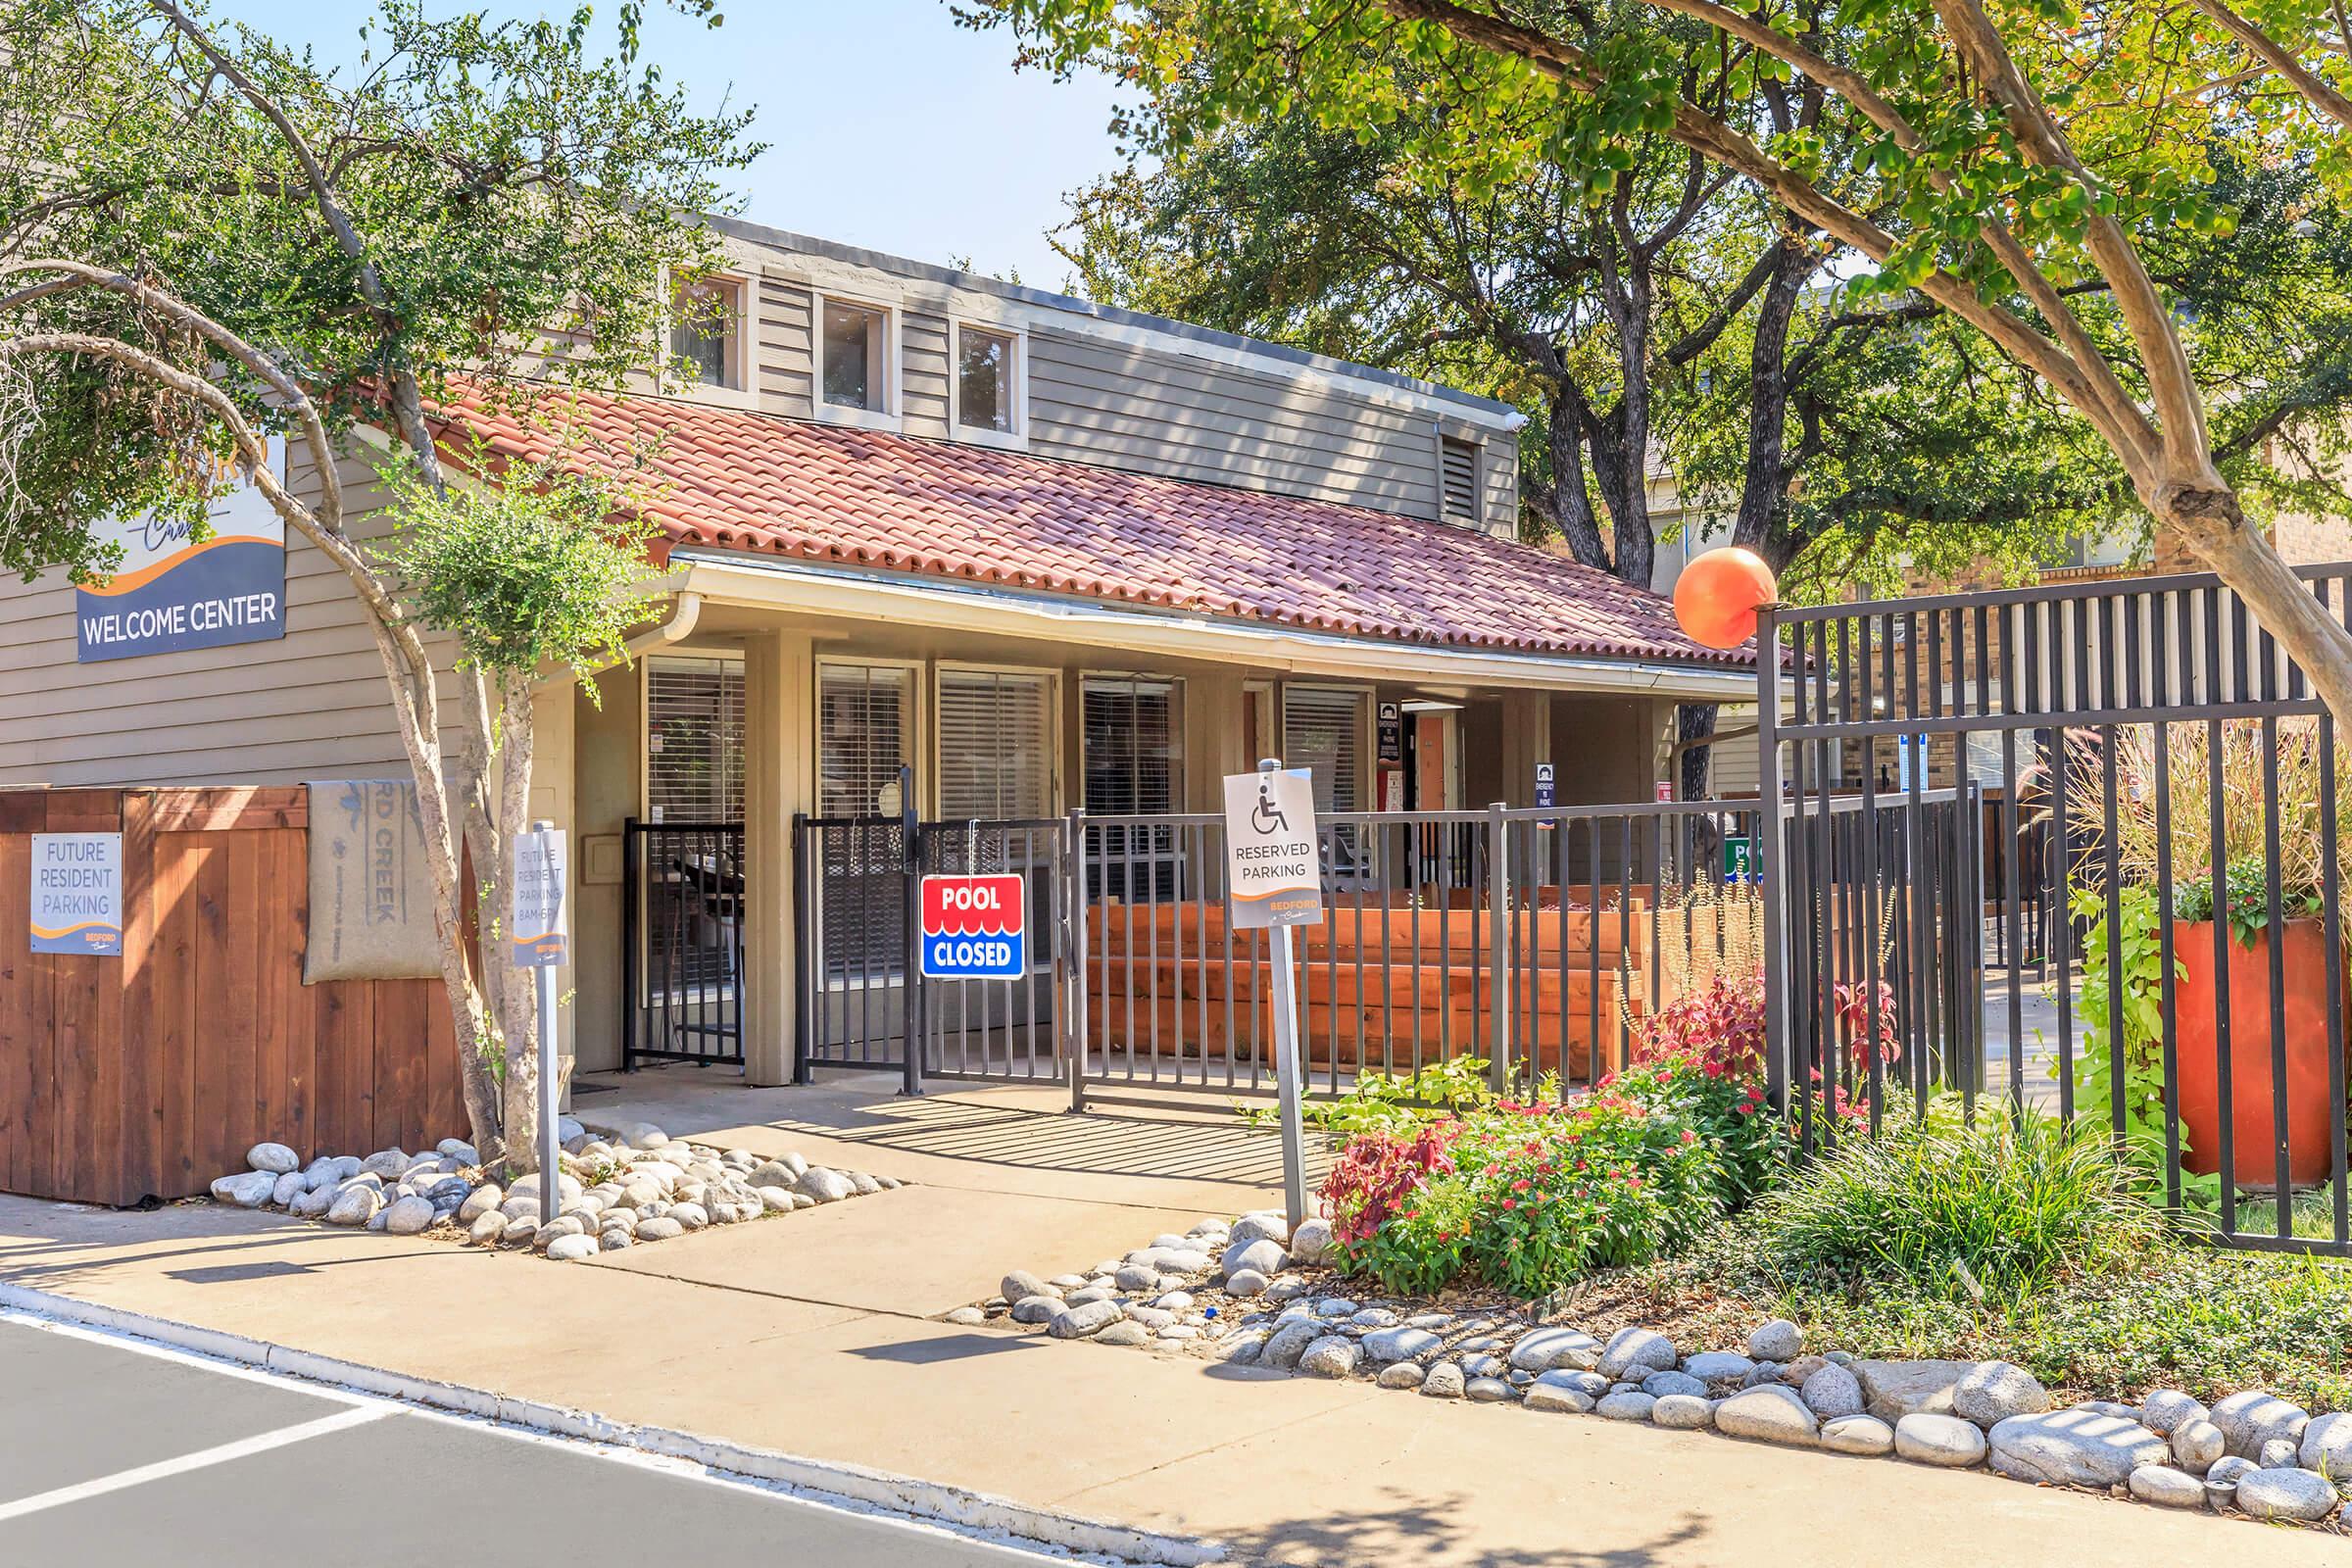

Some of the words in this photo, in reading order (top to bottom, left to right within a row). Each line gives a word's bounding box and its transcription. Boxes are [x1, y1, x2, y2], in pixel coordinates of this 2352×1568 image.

[83, 605, 186, 645] WELCOME
[190, 592, 276, 631] CENTER
[47, 842, 106, 861] FUTURE
[521, 849, 556, 863] FUTURE
[1236, 843, 1310, 860] RESERVED
[40, 868, 113, 888] RESIDENT
[376, 828, 395, 924] CREEK
[518, 868, 562, 882] RESIDENT
[1243, 863, 1306, 880] PARKING
[519, 887, 562, 902] PARKING
[942, 886, 1001, 910] POOL
[42, 895, 110, 914] PARKING
[1270, 900, 1318, 910] BEDFORD
[934, 941, 1011, 966] CLOSED
